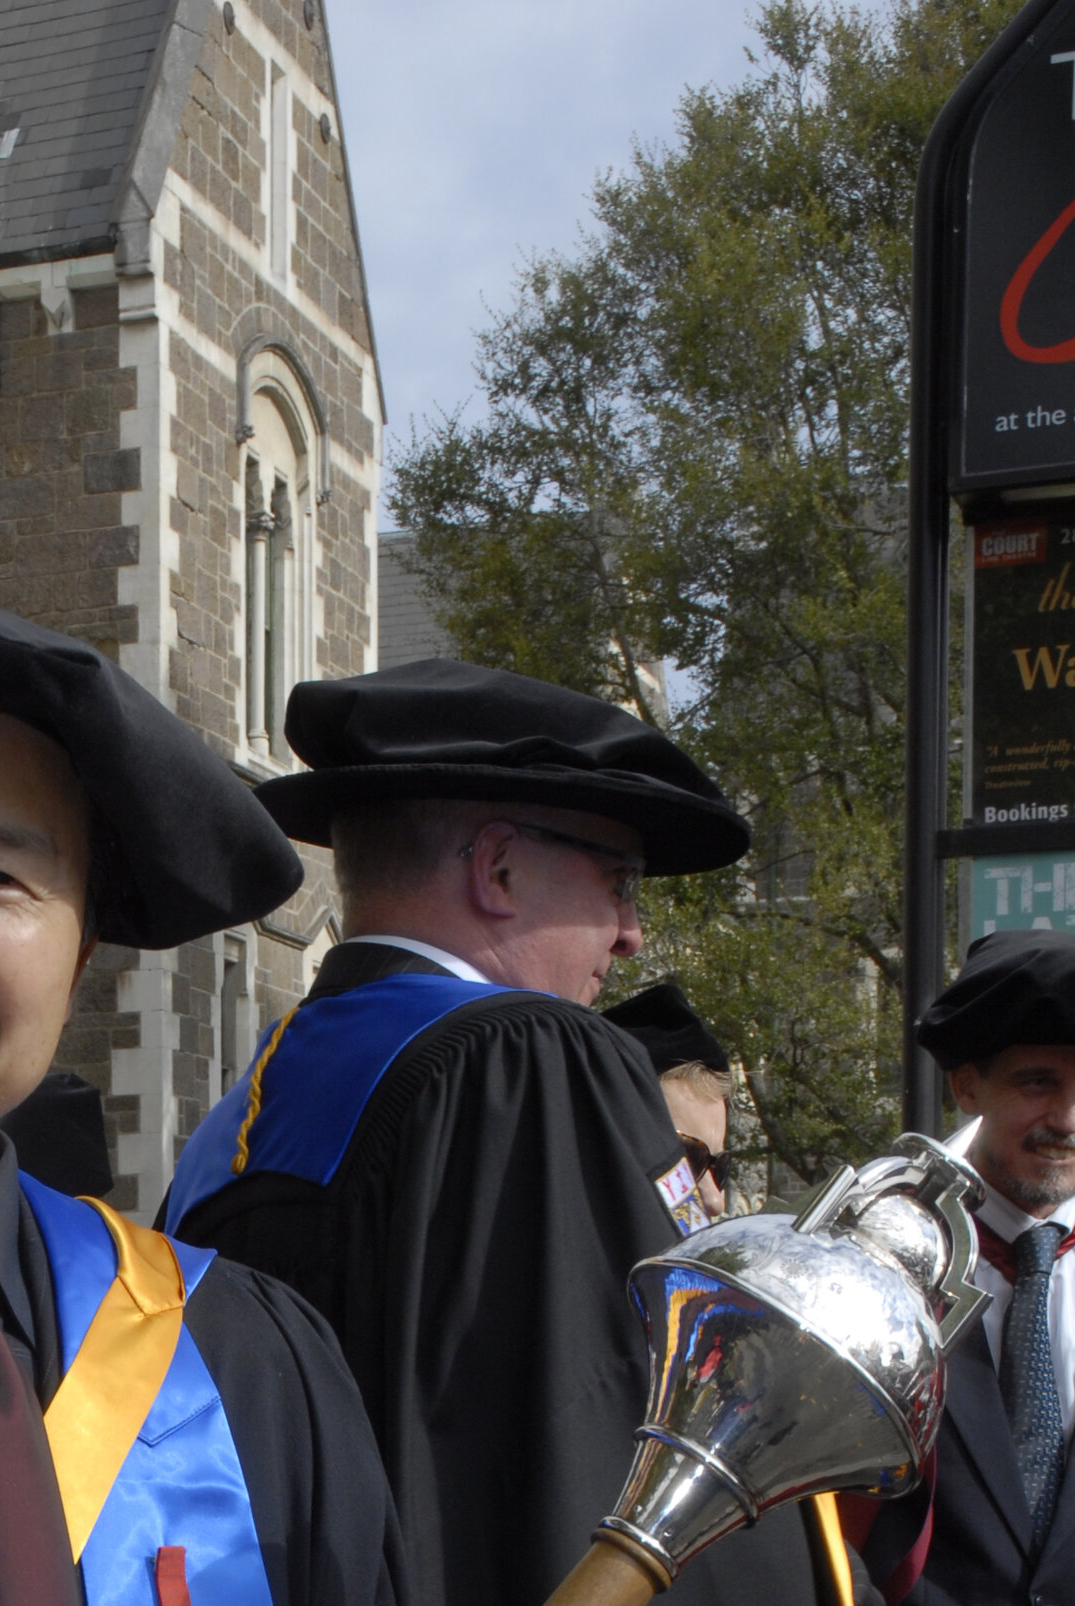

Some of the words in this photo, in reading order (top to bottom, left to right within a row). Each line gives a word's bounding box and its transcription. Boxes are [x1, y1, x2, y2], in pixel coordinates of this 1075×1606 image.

[995, 412, 1020, 432] at
[1026, 405, 1067, 429] the
[981, 533, 1039, 555] COURT
[1037, 560, 1075, 613] th
[984, 802, 1069, 823] Bookings
